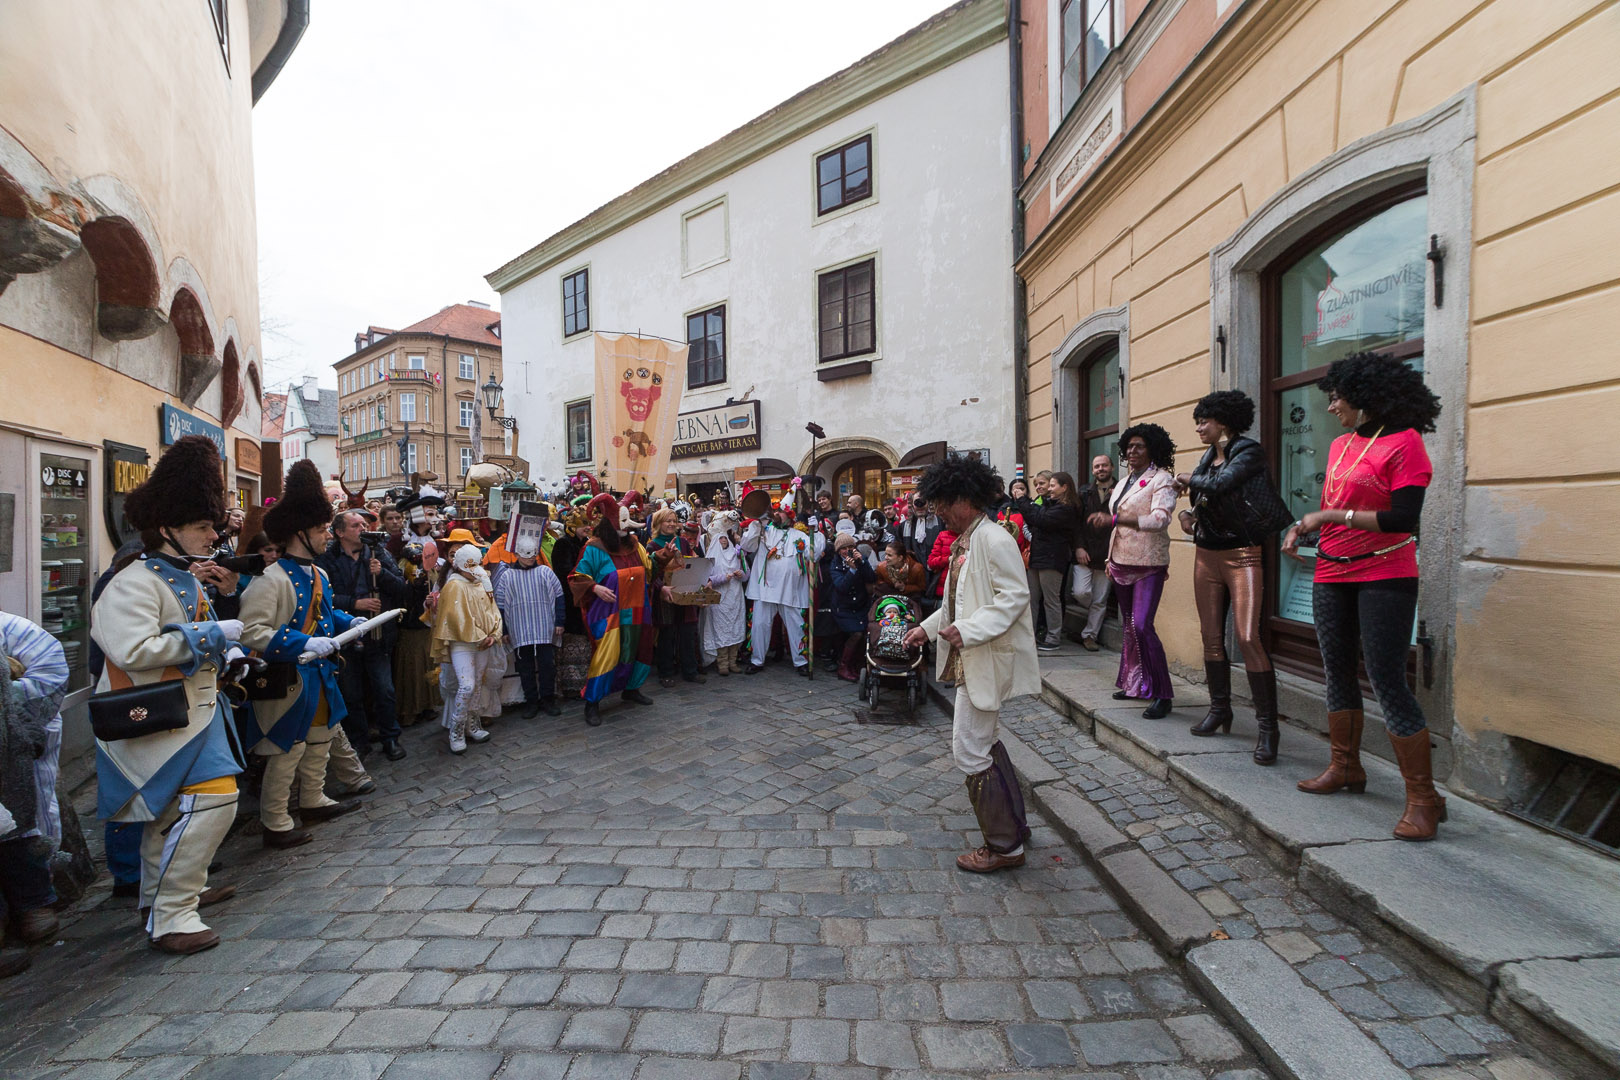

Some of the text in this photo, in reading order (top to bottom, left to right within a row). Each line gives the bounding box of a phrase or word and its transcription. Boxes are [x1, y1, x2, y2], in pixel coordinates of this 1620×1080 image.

[181, 418, 193, 433] DISC
[1283, 424, 1313, 436] PRECIOSA
[691, 442, 709, 454] CAFE
[710, 441, 723, 451] BAR
[728, 436, 757, 449] TERASA
[57, 468, 72, 479] DISC
